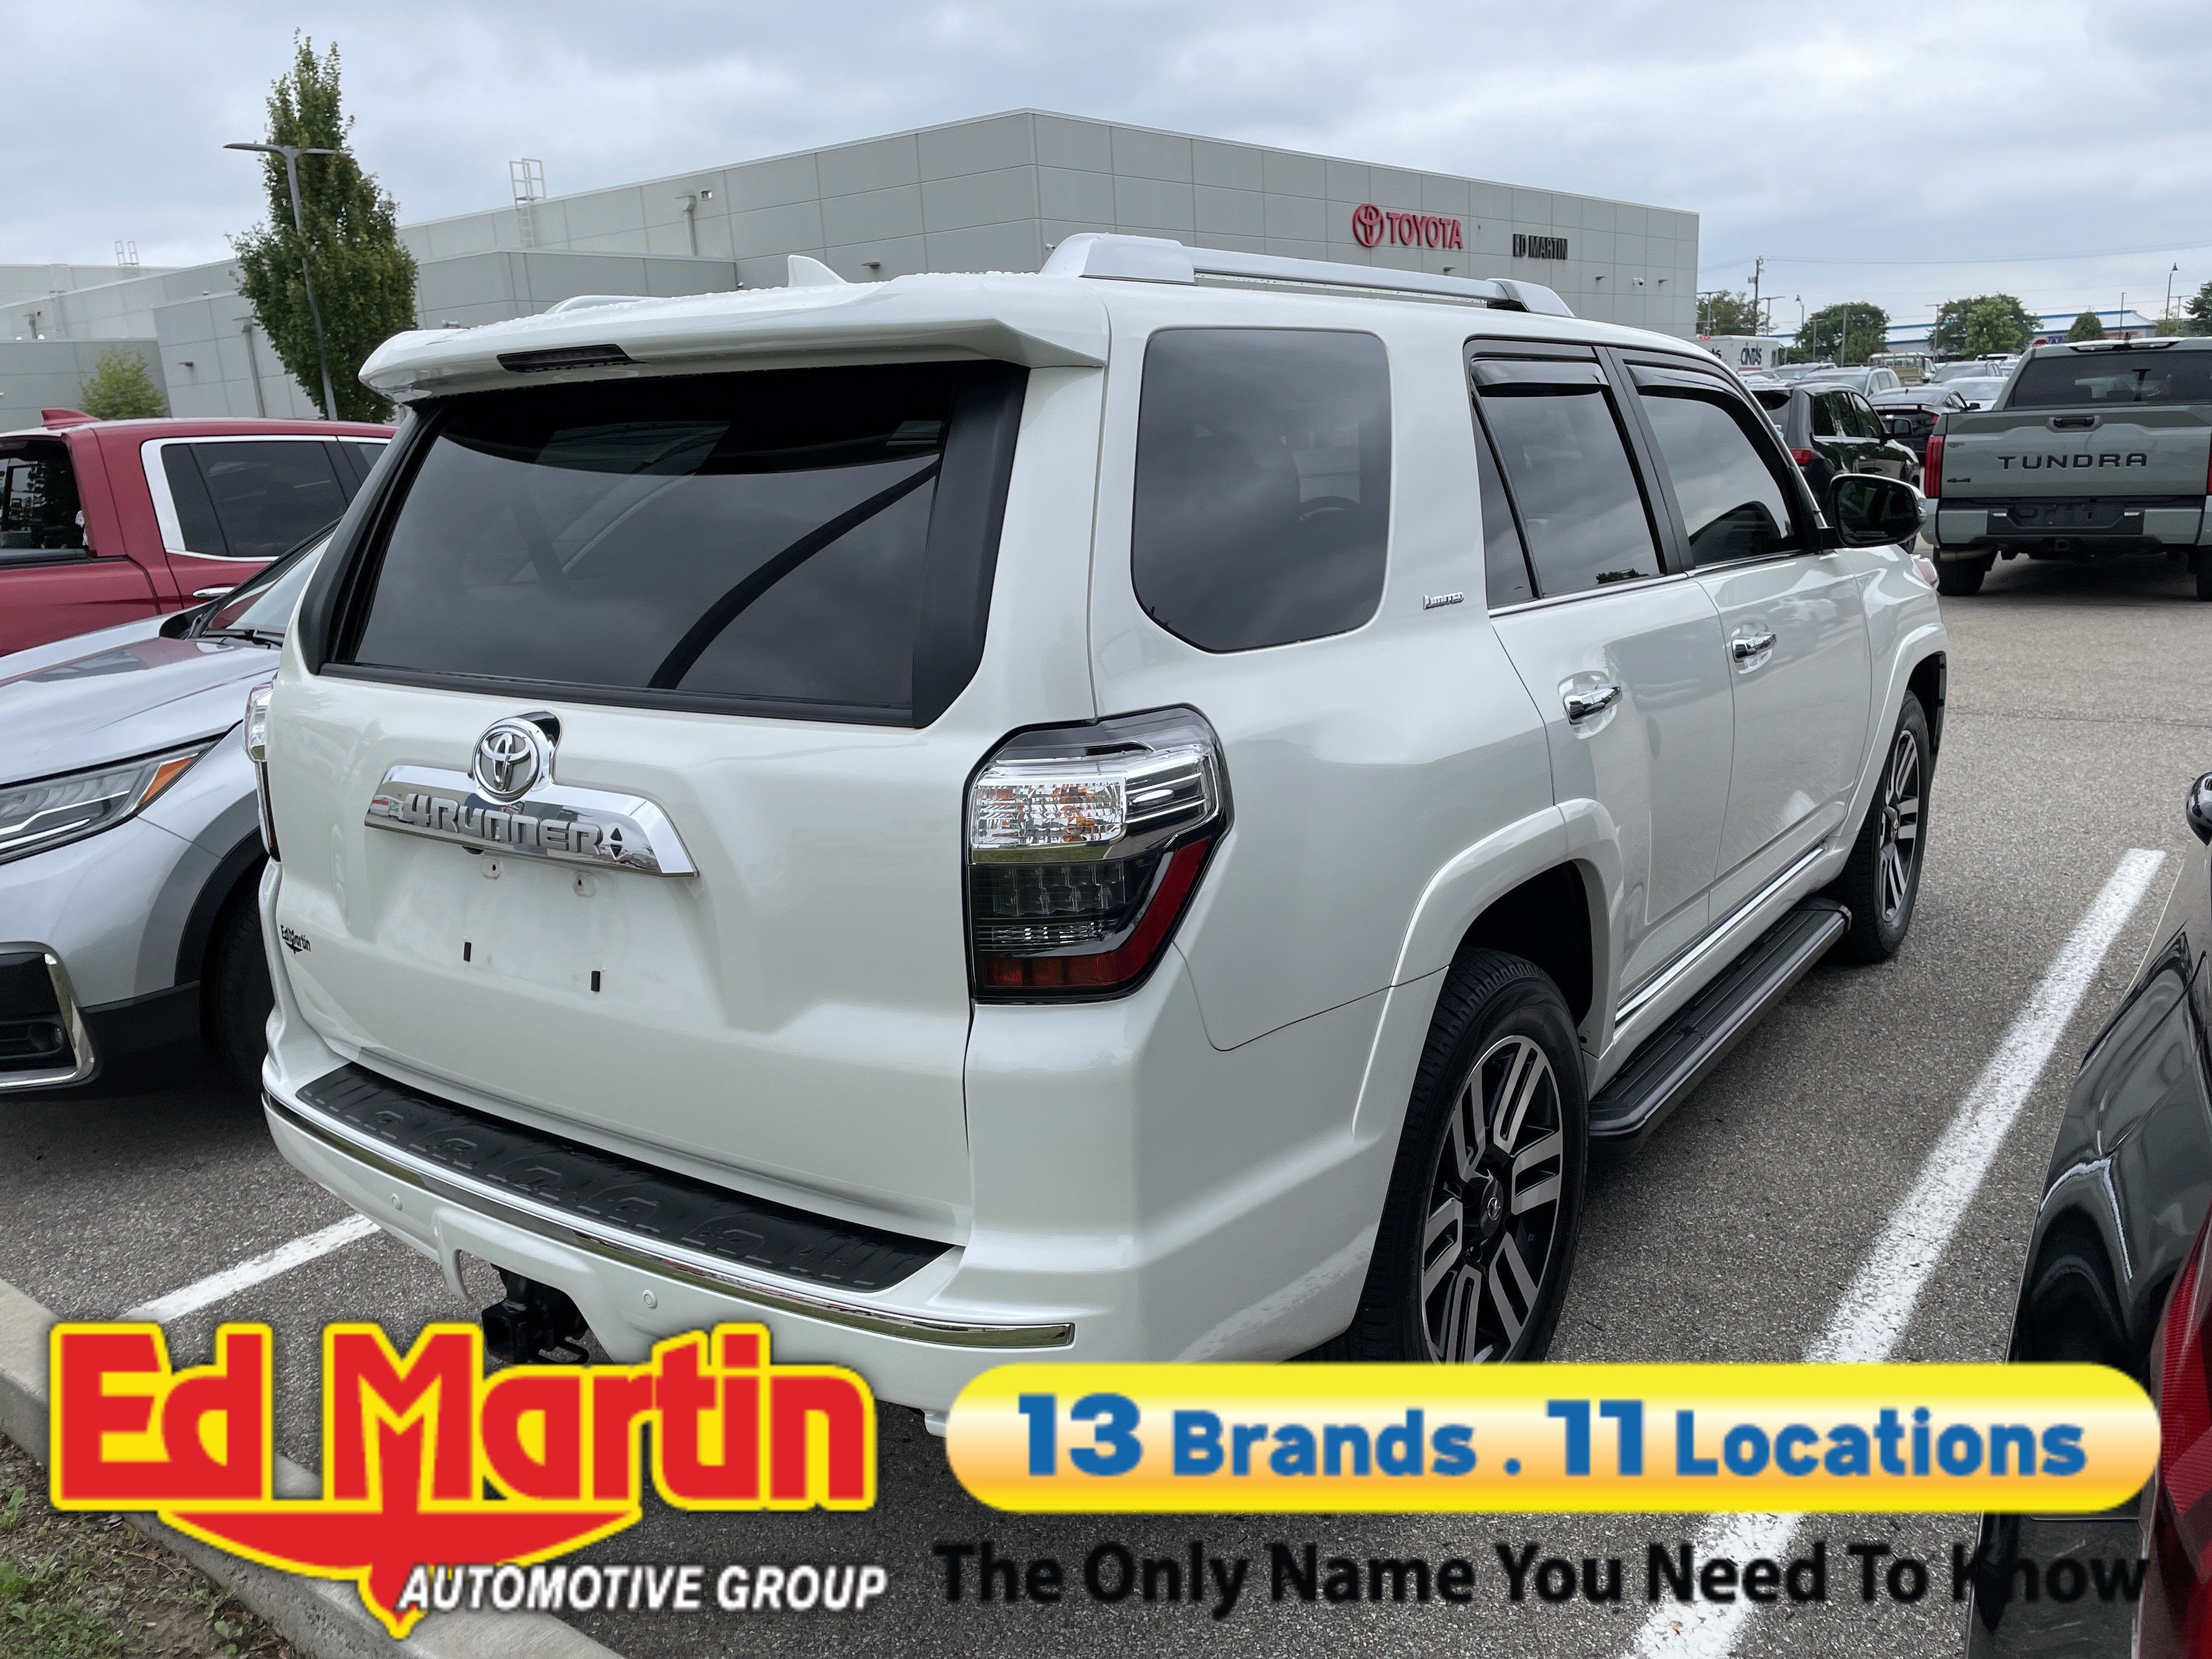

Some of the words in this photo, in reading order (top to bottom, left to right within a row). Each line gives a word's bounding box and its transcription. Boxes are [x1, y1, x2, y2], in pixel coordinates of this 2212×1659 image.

[1386, 212, 1464, 249] TOYOTA
[1513, 233, 1526, 257] ED
[1528, 235, 1568, 260] MARTIN
[1997, 453, 2147, 469] TUNDRA
[399, 793, 603, 855] 4RUNNER
